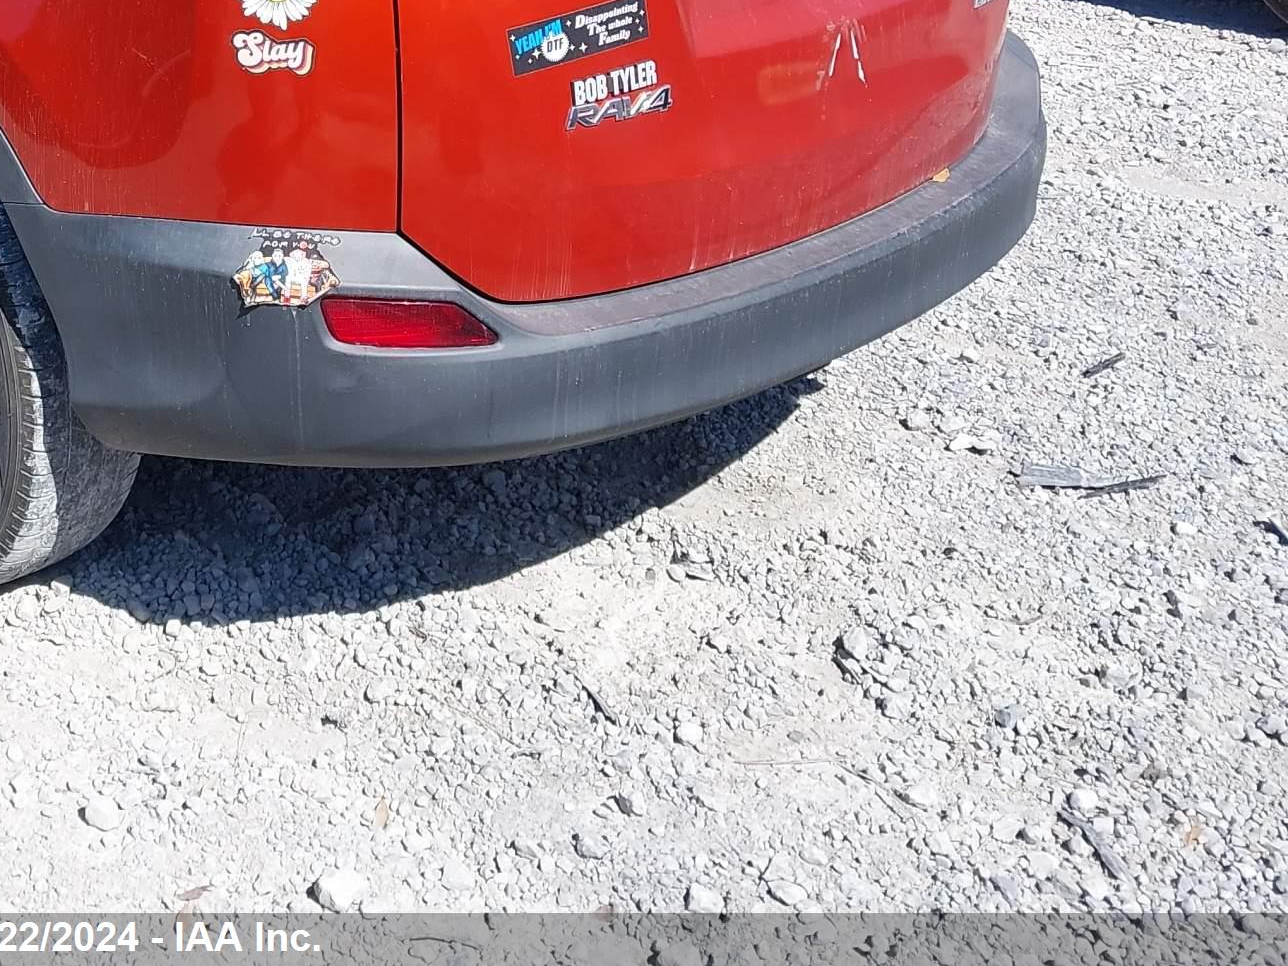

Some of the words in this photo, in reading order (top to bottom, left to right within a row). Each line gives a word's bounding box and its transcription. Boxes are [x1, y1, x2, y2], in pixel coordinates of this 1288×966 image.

[574, 1, 639, 30] Disappointing
[586, 22, 607, 37] The
[607, 15, 633, 31] whole
[515, 28, 544, 55] YEAH
[546, 37, 564, 53] DTF
[598, 29, 631, 47] Family
[232, 31, 314, 75] Slay
[572, 73, 609, 107] BOB
[610, 59, 658, 96] TYLER
[565, 84, 673, 131] RAV4
